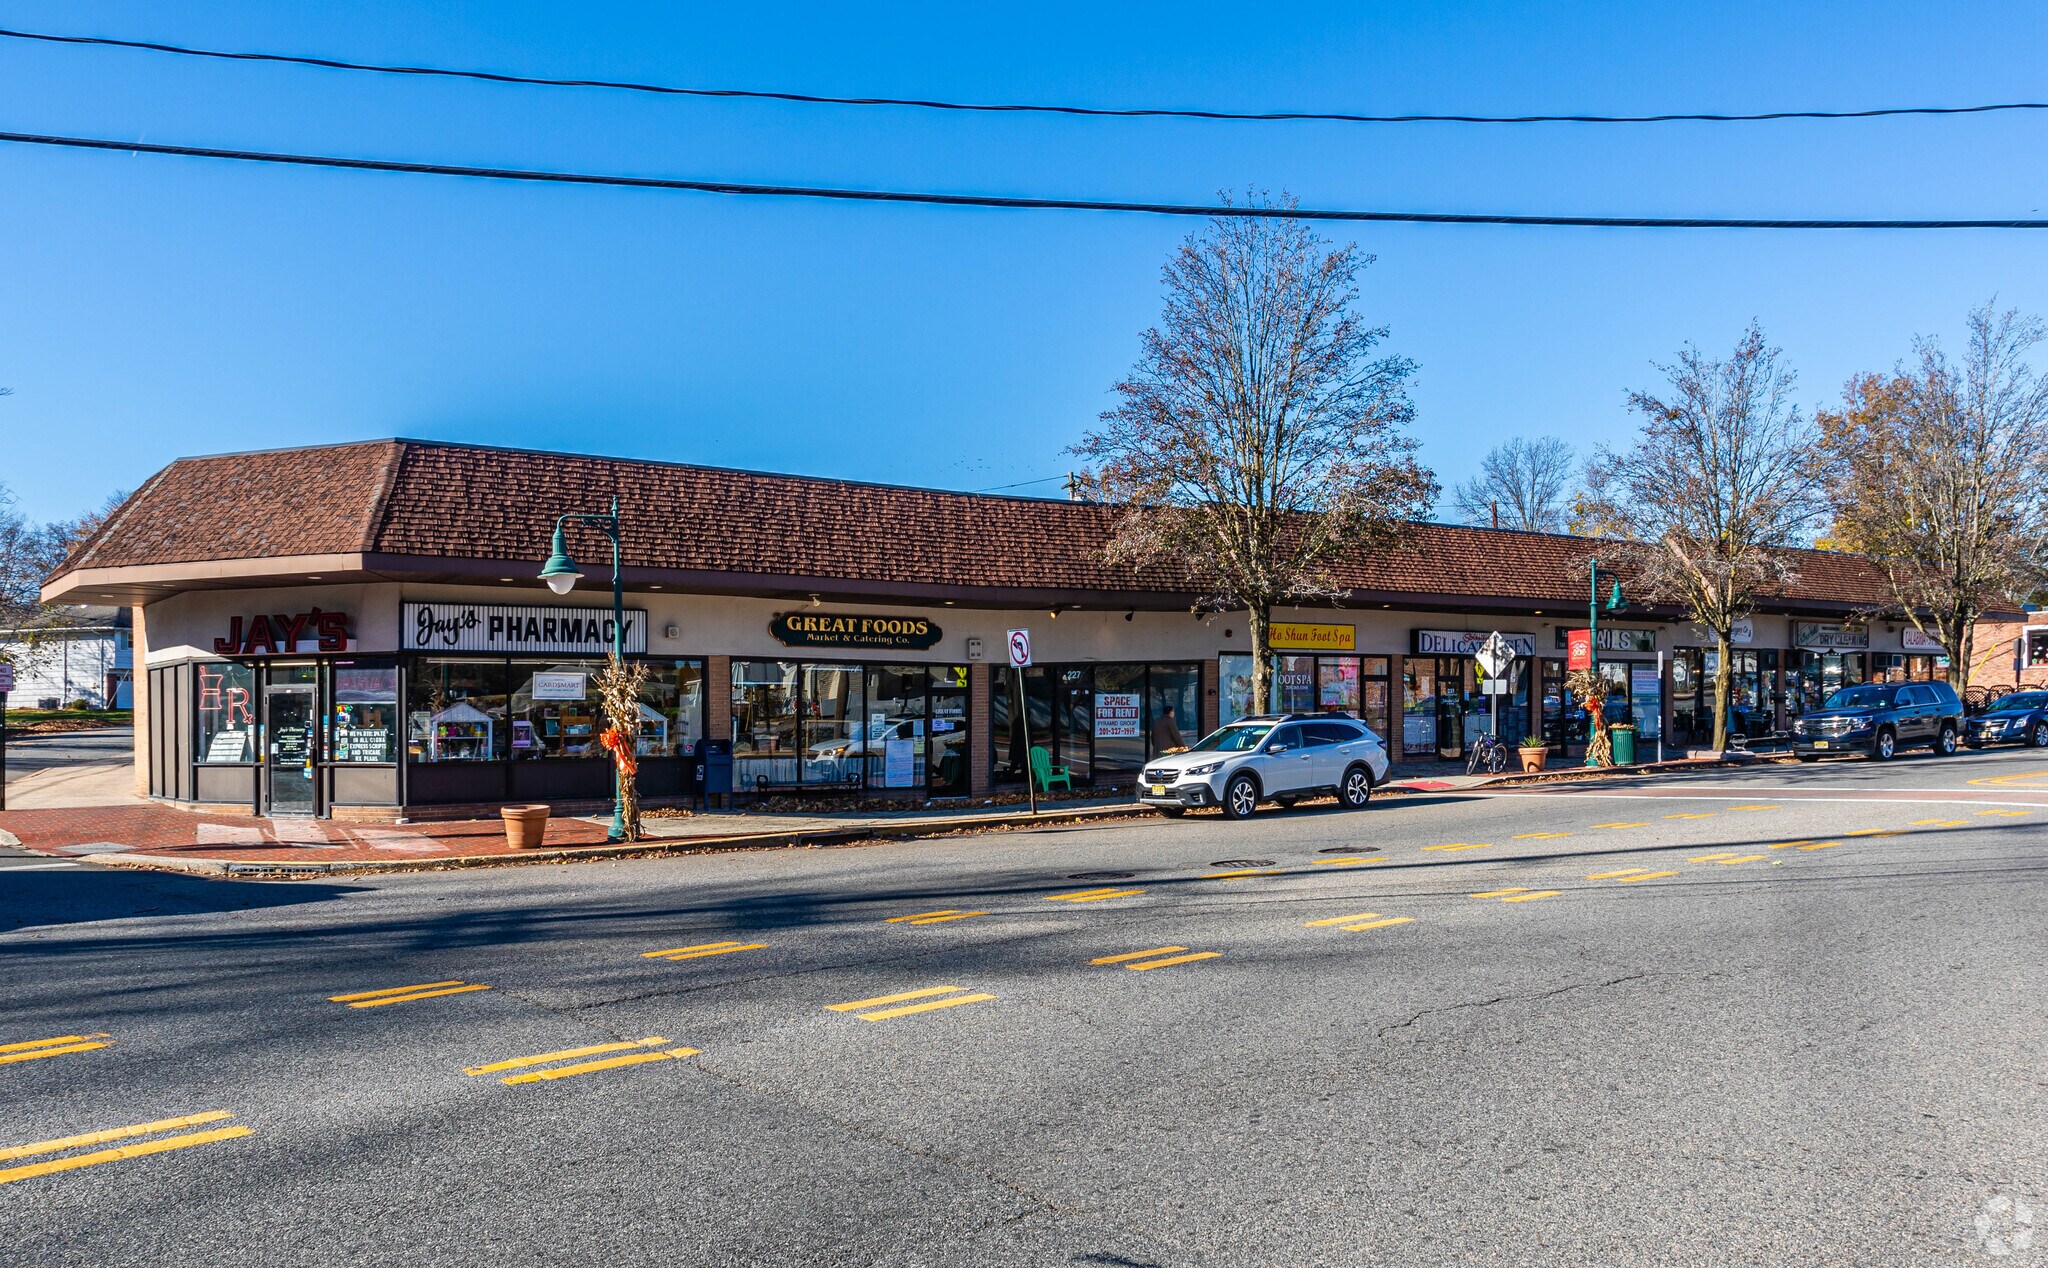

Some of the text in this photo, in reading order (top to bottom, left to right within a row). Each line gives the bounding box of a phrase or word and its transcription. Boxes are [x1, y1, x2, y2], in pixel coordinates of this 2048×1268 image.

[214, 606, 348, 654] JAY'S
[416, 607, 633, 646] Jay's PHARMACY
[786, 616, 928, 635] GREAT FOODS
[806, 633, 910, 645] Market & Catering Co.
[1285, 627, 1309, 641] Shun
[1311, 628, 1331, 642] Foot
[1333, 629, 1352, 646] Spa
[1597, 630, 1632, 649] AILS
[1820, 634, 1834, 645] DRY
[1421, 633, 1534, 656] DELICATSEN
[1067, 671, 1081, 679] 227
[1296, 675, 1312, 684] SPA
[1104, 696, 1131, 706] SPACE
[1097, 709, 1136, 718] FOR RENT
